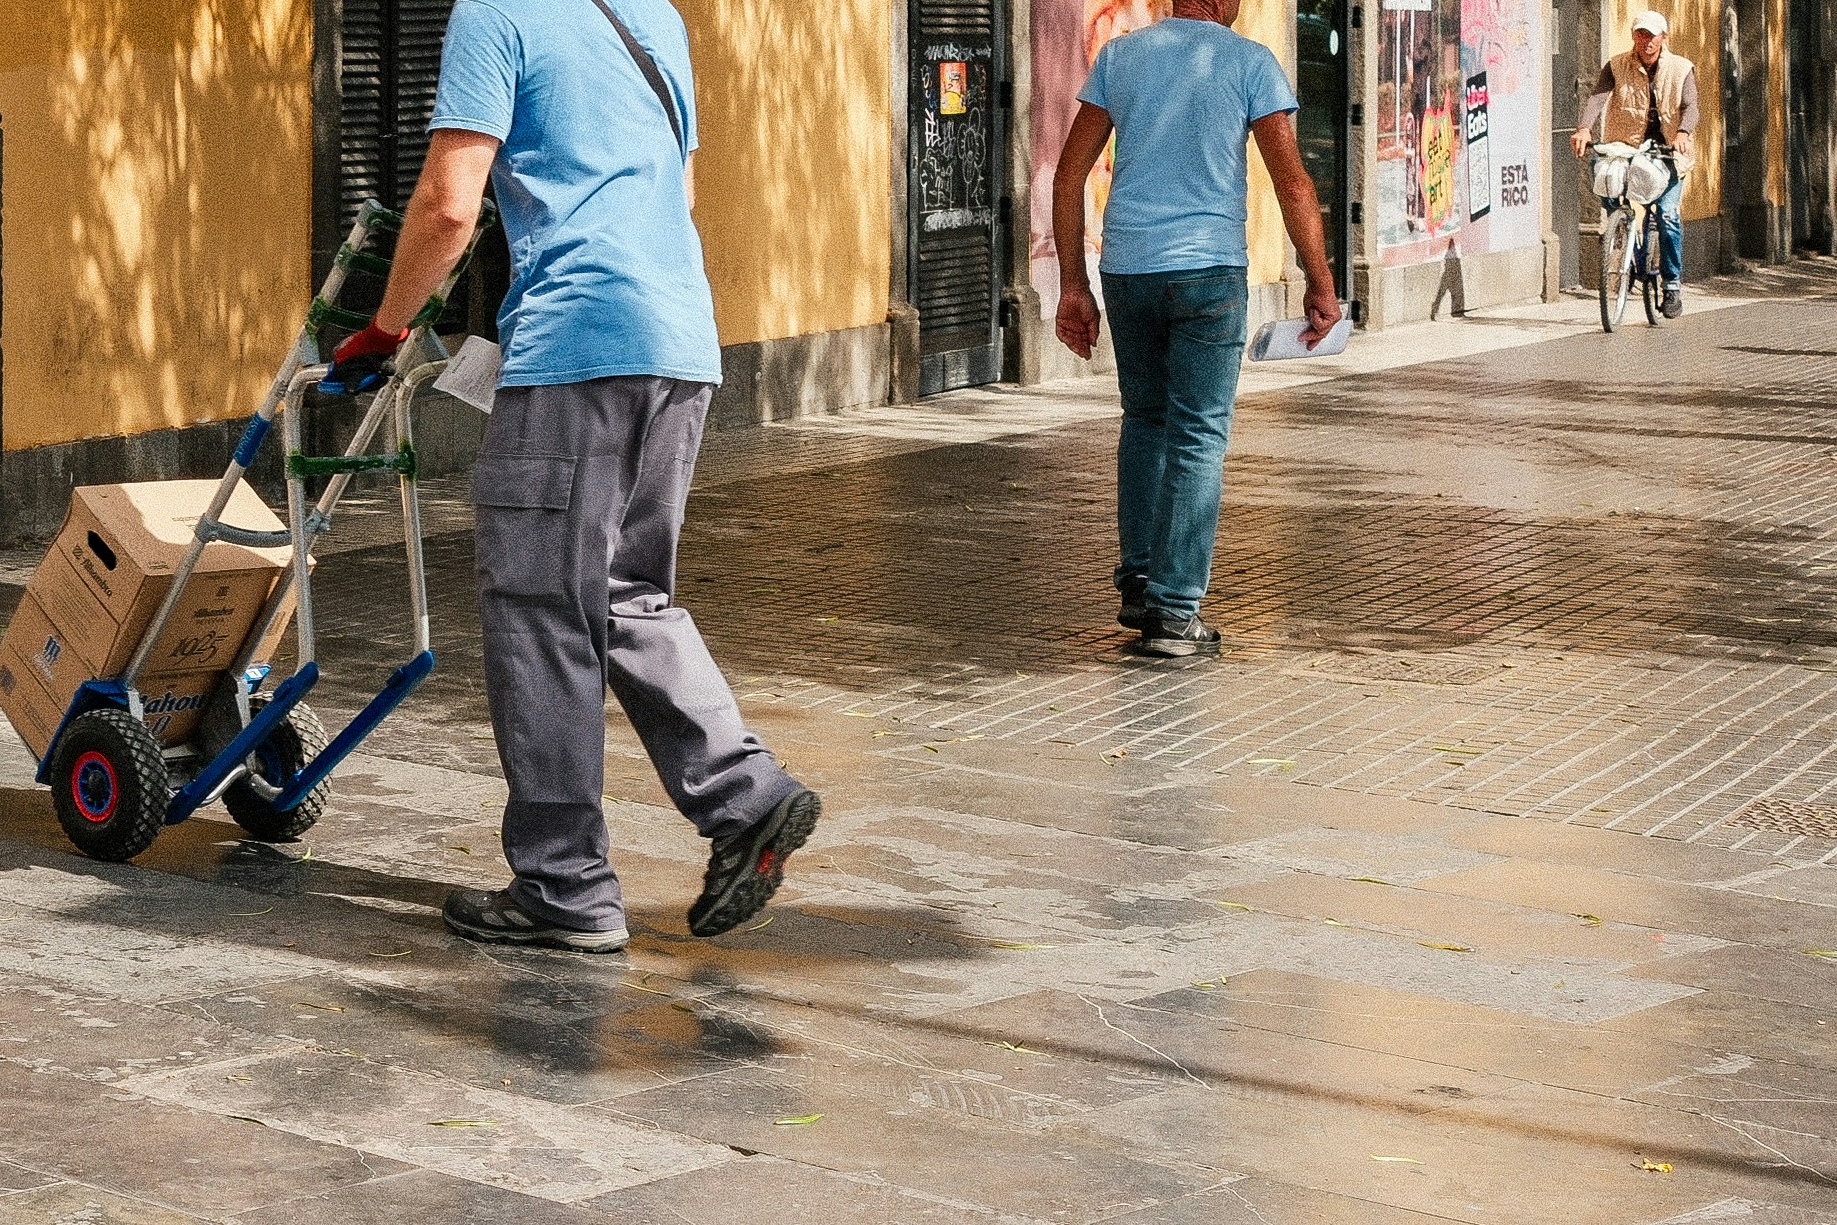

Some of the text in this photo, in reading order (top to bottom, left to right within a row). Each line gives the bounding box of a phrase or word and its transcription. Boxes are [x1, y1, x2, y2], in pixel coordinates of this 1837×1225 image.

[1466, 84, 1489, 111] Uber
[1467, 110, 1488, 140] Eats
[1501, 159, 1529, 185] ESTÁ
[1501, 185, 1529, 208] RICO
[167, 630, 230, 664] 1925
[141, 692, 203, 714] ahou
